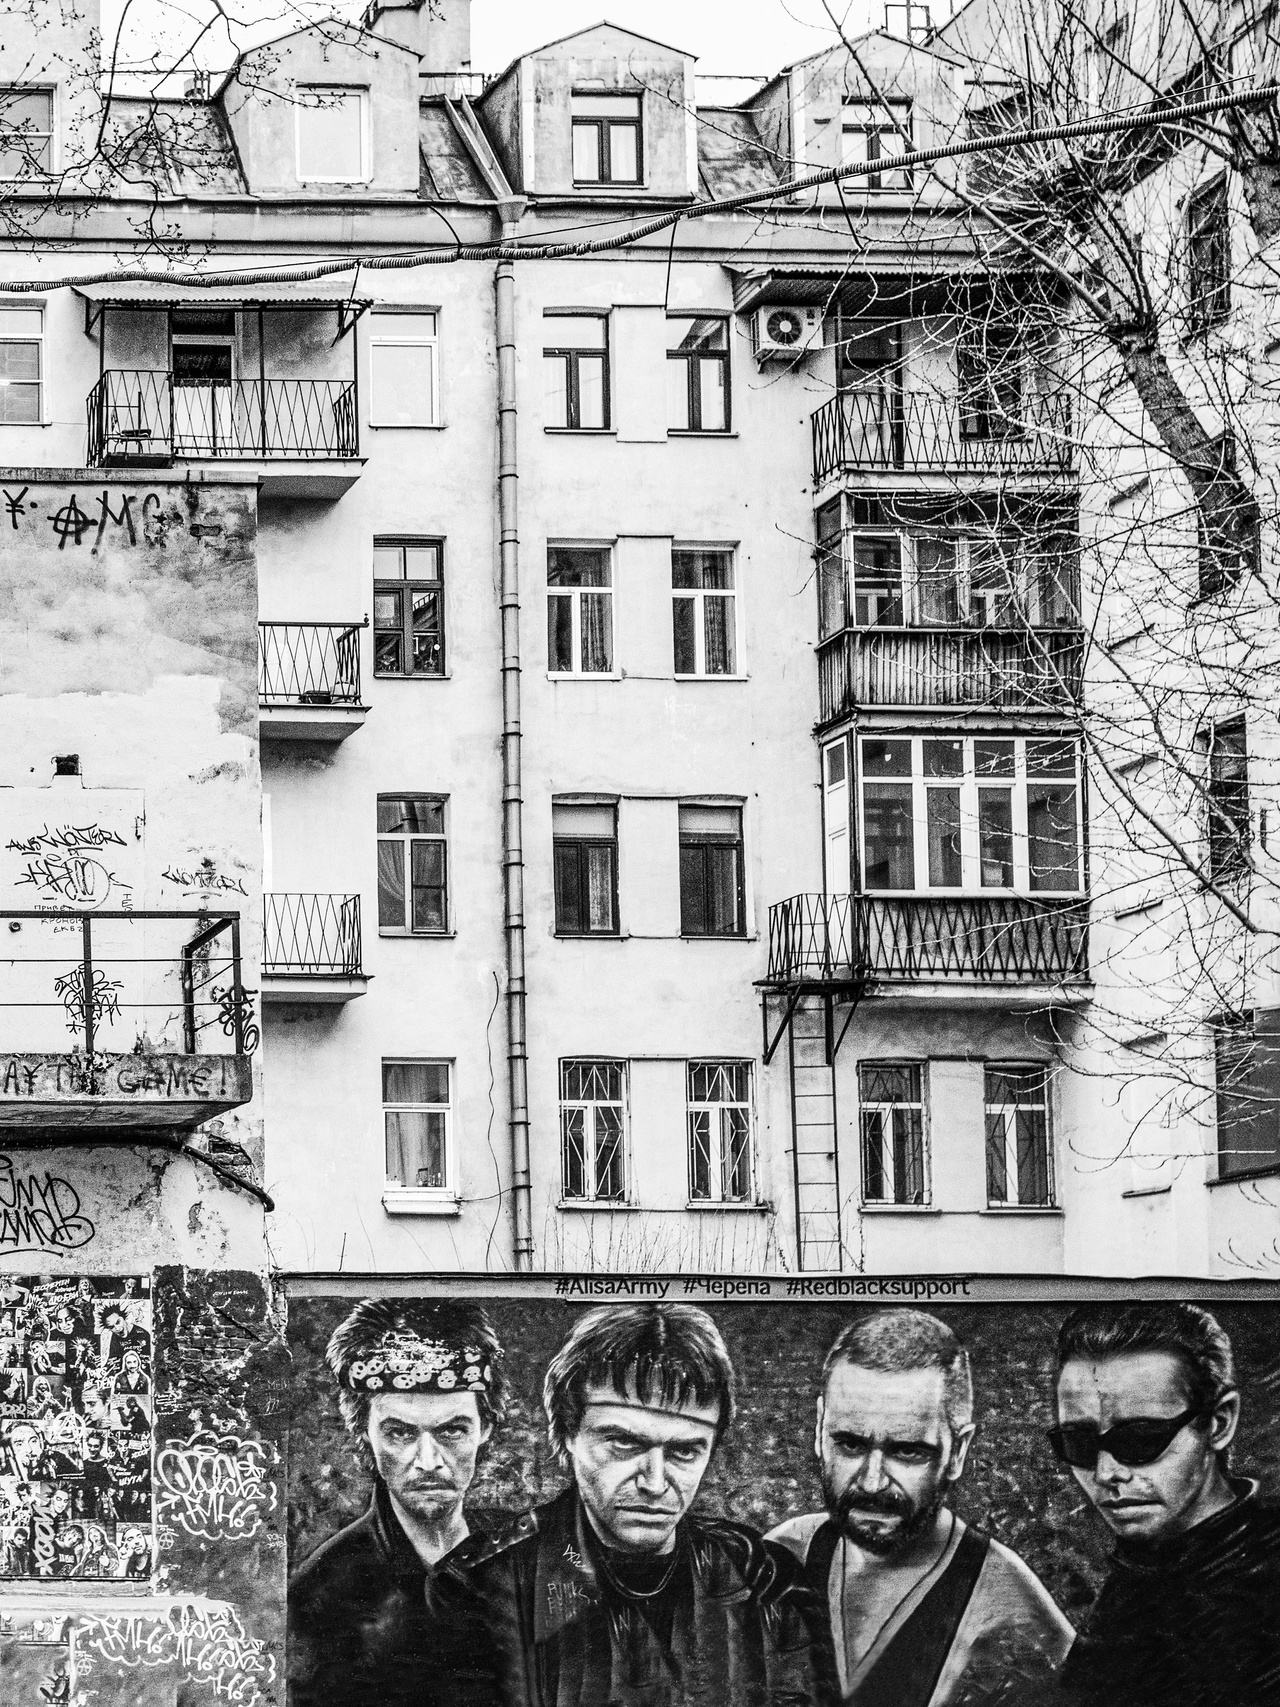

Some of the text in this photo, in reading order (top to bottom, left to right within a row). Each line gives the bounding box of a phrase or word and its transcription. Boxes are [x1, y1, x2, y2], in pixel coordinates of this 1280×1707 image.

[555, 1278, 971, 1298] #AlisaArmy #Черепа #Redblacksupport
